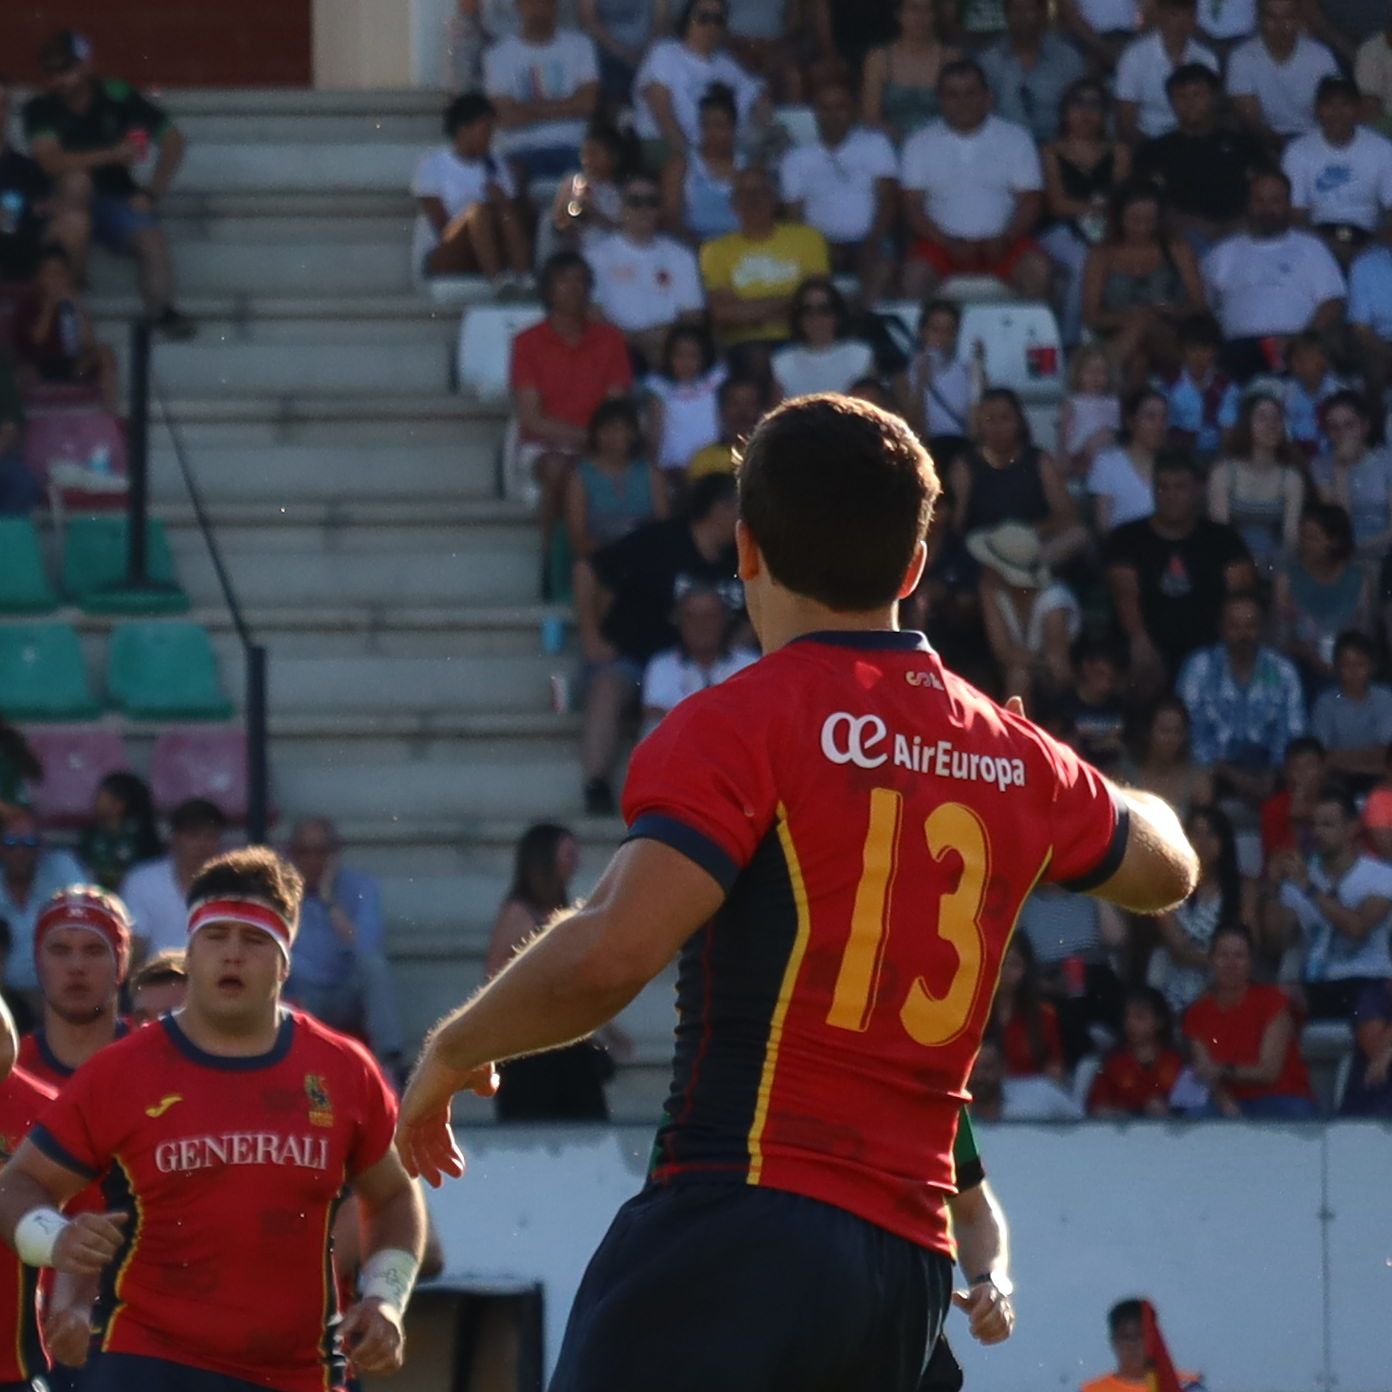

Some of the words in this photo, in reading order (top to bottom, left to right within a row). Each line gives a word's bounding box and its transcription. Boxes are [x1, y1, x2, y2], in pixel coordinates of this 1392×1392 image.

[893, 734, 1025, 792] AirEuropa
[826, 787, 992, 1048] 13
[155, 1131, 329, 1172] GENERALI
